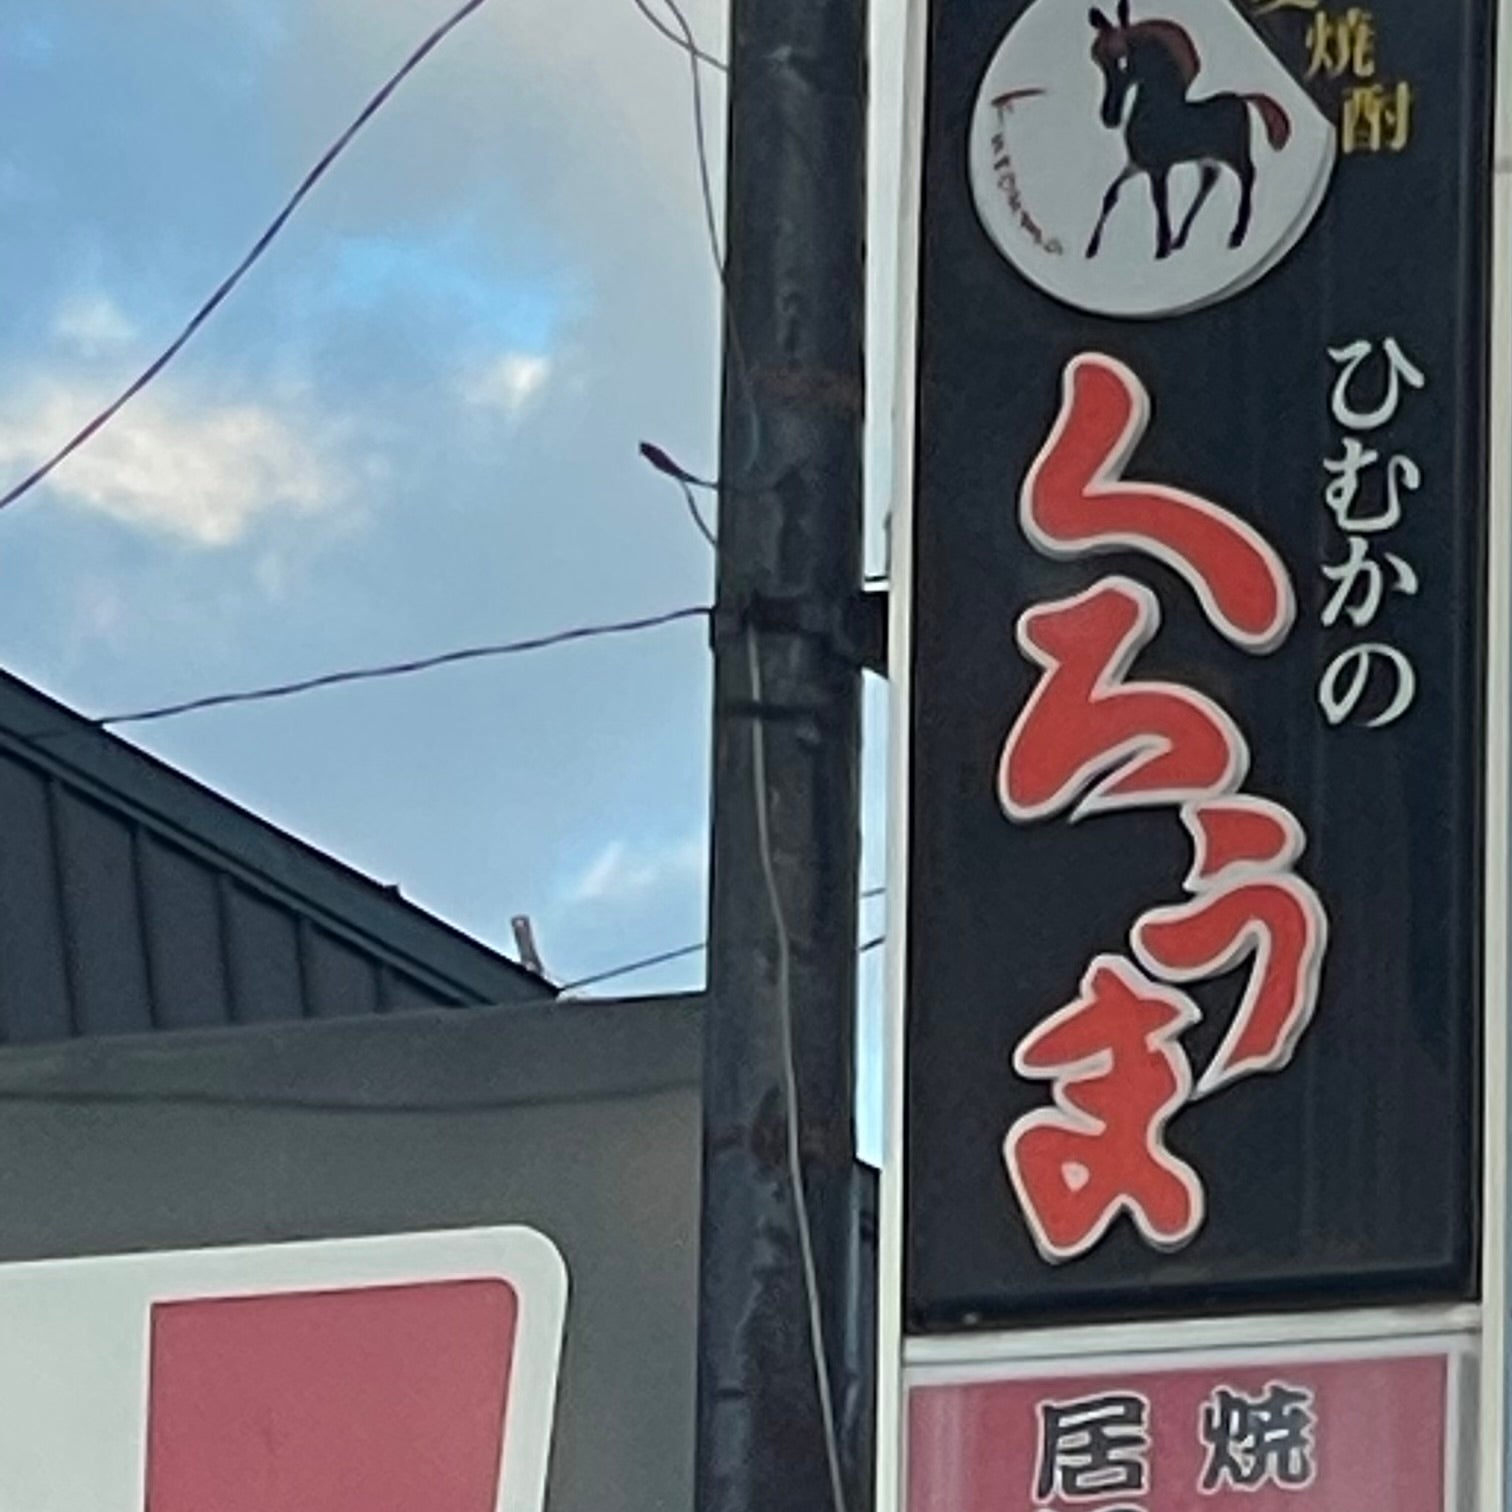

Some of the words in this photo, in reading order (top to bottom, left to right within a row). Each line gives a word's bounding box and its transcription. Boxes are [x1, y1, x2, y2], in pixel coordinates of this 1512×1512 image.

[1254, 0, 1410, 154] 焼酎
[1318, 337, 1425, 728] ひむかの
[999, 351, 1329, 1265] くろうま
